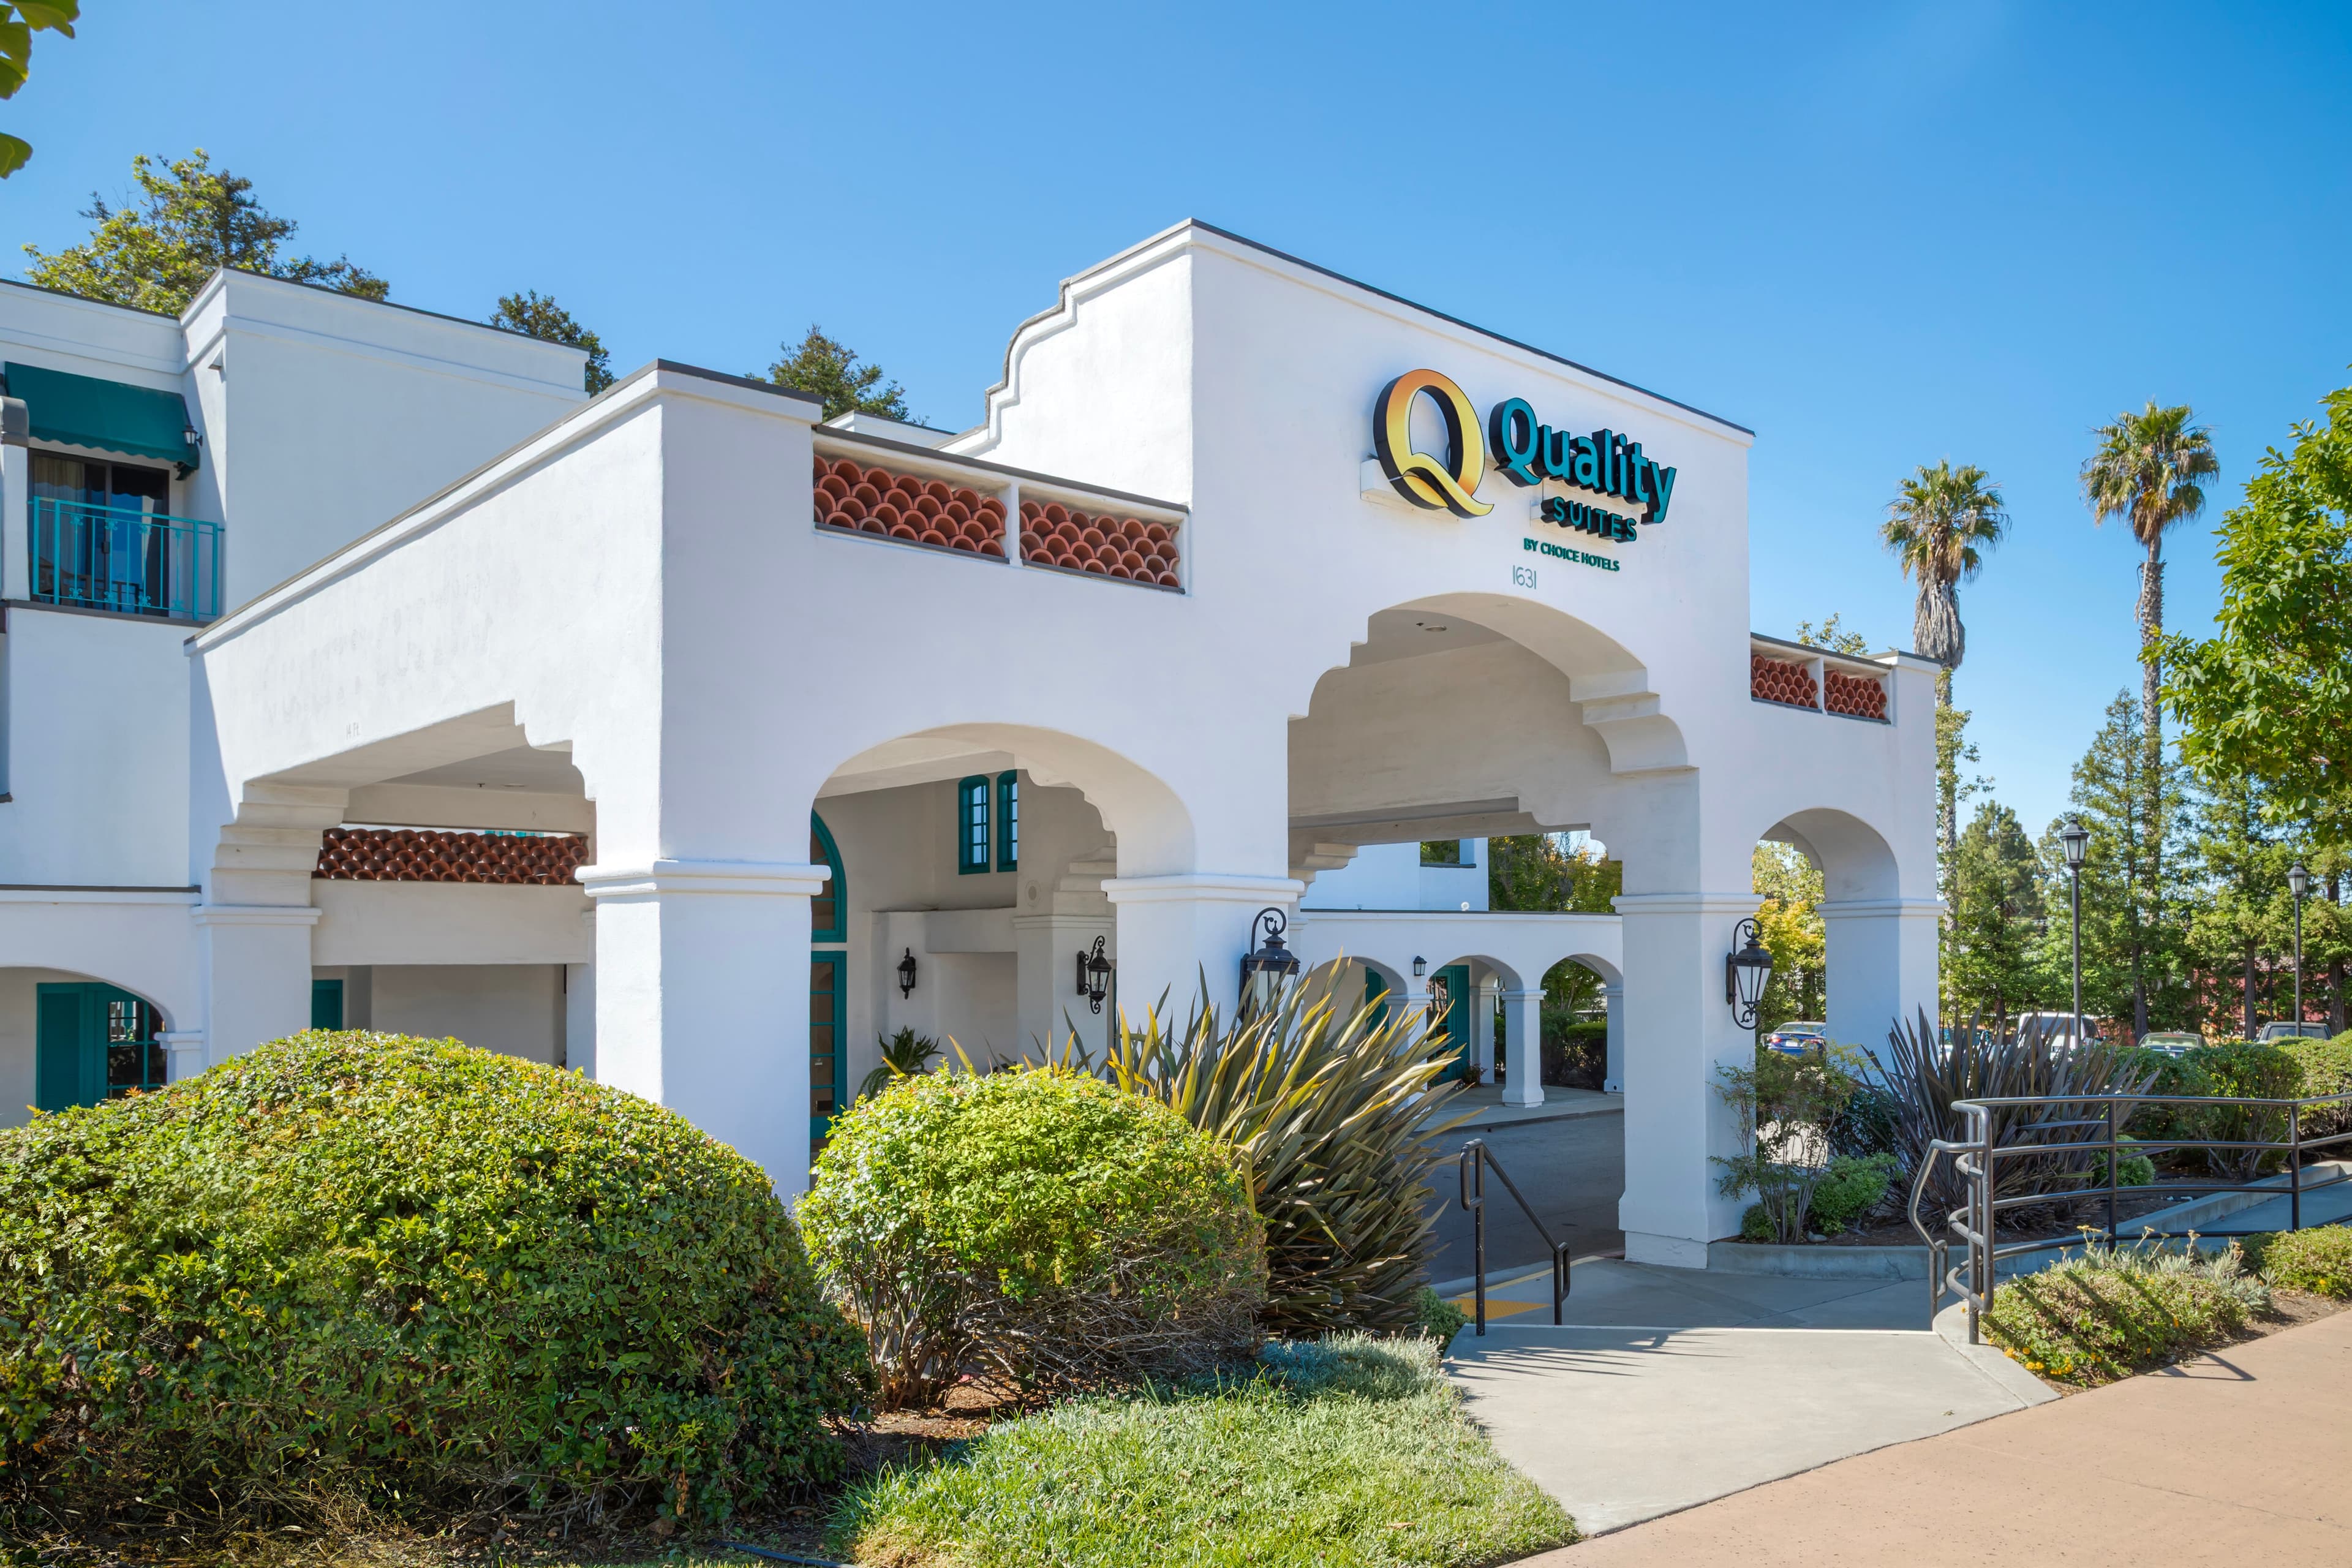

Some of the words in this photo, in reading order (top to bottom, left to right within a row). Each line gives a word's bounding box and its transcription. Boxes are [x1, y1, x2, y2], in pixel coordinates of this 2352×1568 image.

[1374, 369, 1494, 519] Q
[1489, 398, 1677, 524] Quality
[1541, 497, 1637, 543] SUITES
[1512, 565, 1537, 590] 1631
[1523, 538, 1539, 552] BY
[1540, 542, 1580, 563] CHOICE
[1581, 552, 1621, 572] HOTELS
